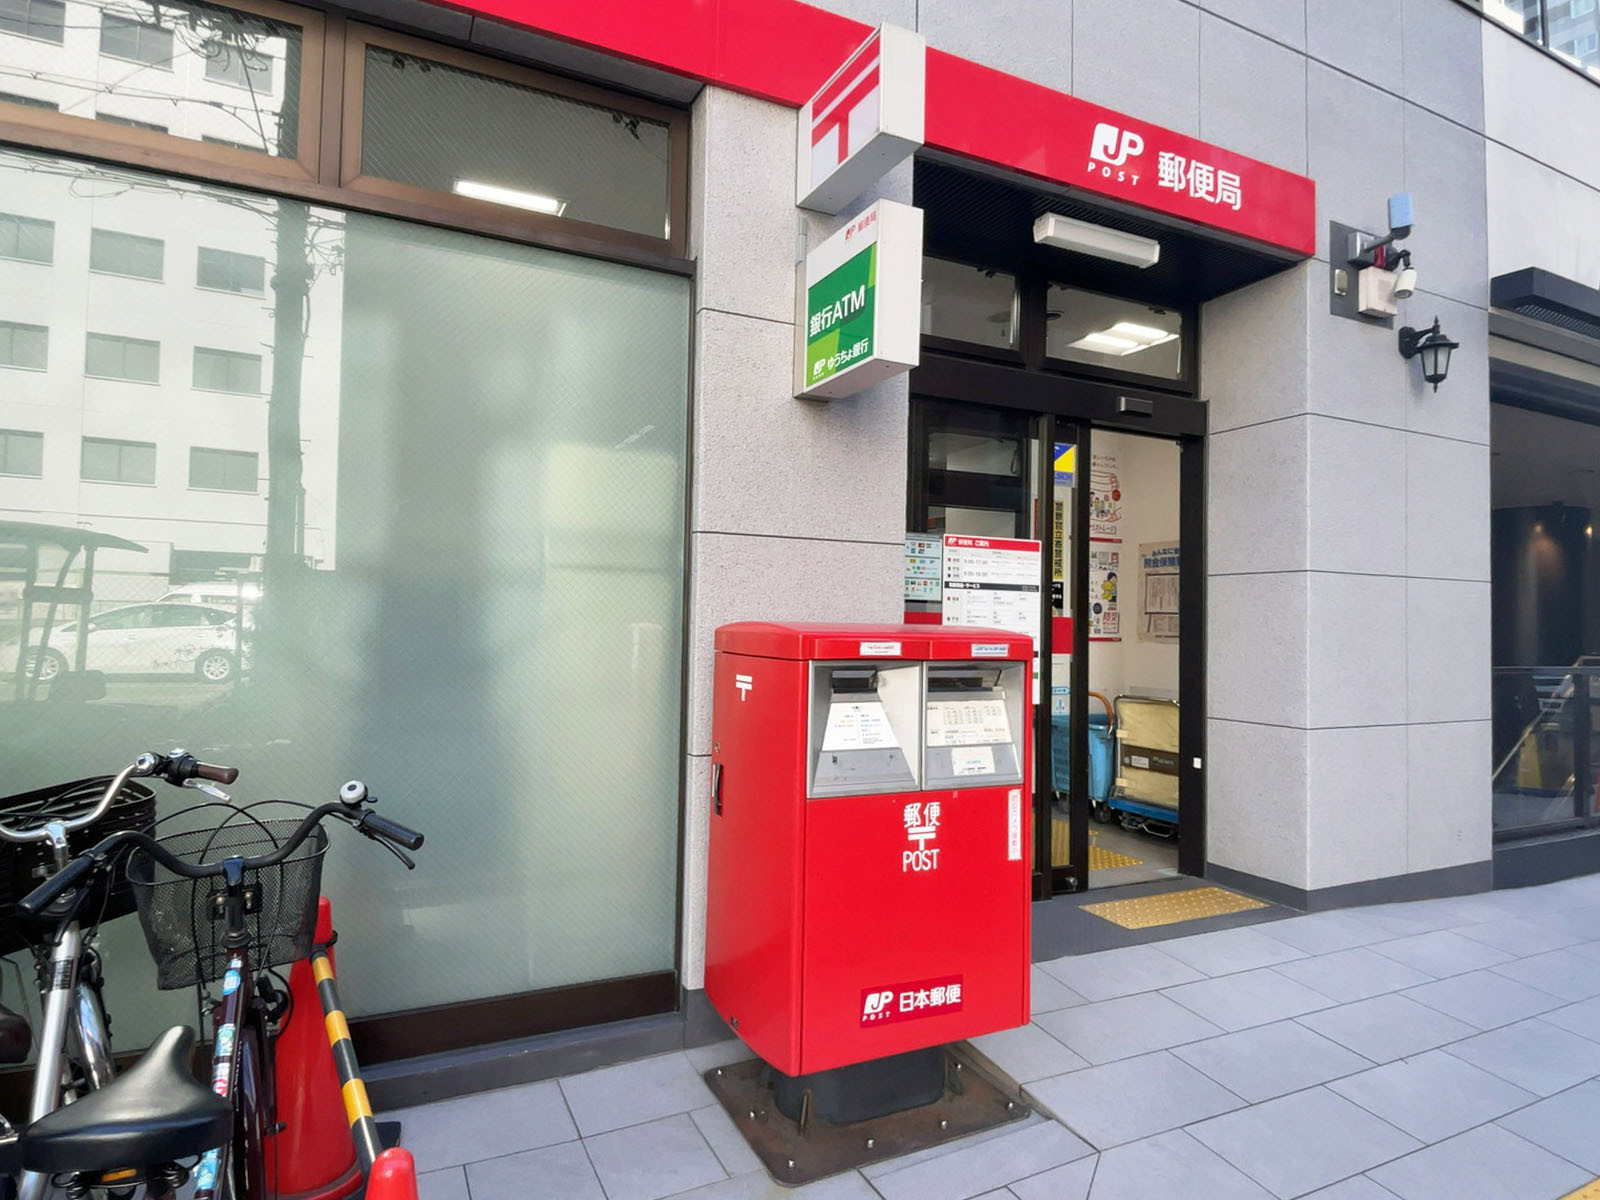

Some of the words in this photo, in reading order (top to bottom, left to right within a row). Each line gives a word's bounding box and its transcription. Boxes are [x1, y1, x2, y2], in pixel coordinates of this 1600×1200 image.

[1087, 161, 1140, 186] POST
[1157, 151, 1242, 211] 郵便局
[809, 284, 866, 338] 銀行ATM
[827, 337, 869, 371] ゆうちょ銀行
[903, 801, 941, 828] 郵便
[903, 848, 940, 873] POST
[899, 983, 961, 1013] 日本郵便
[861, 1011, 891, 1022] POST
